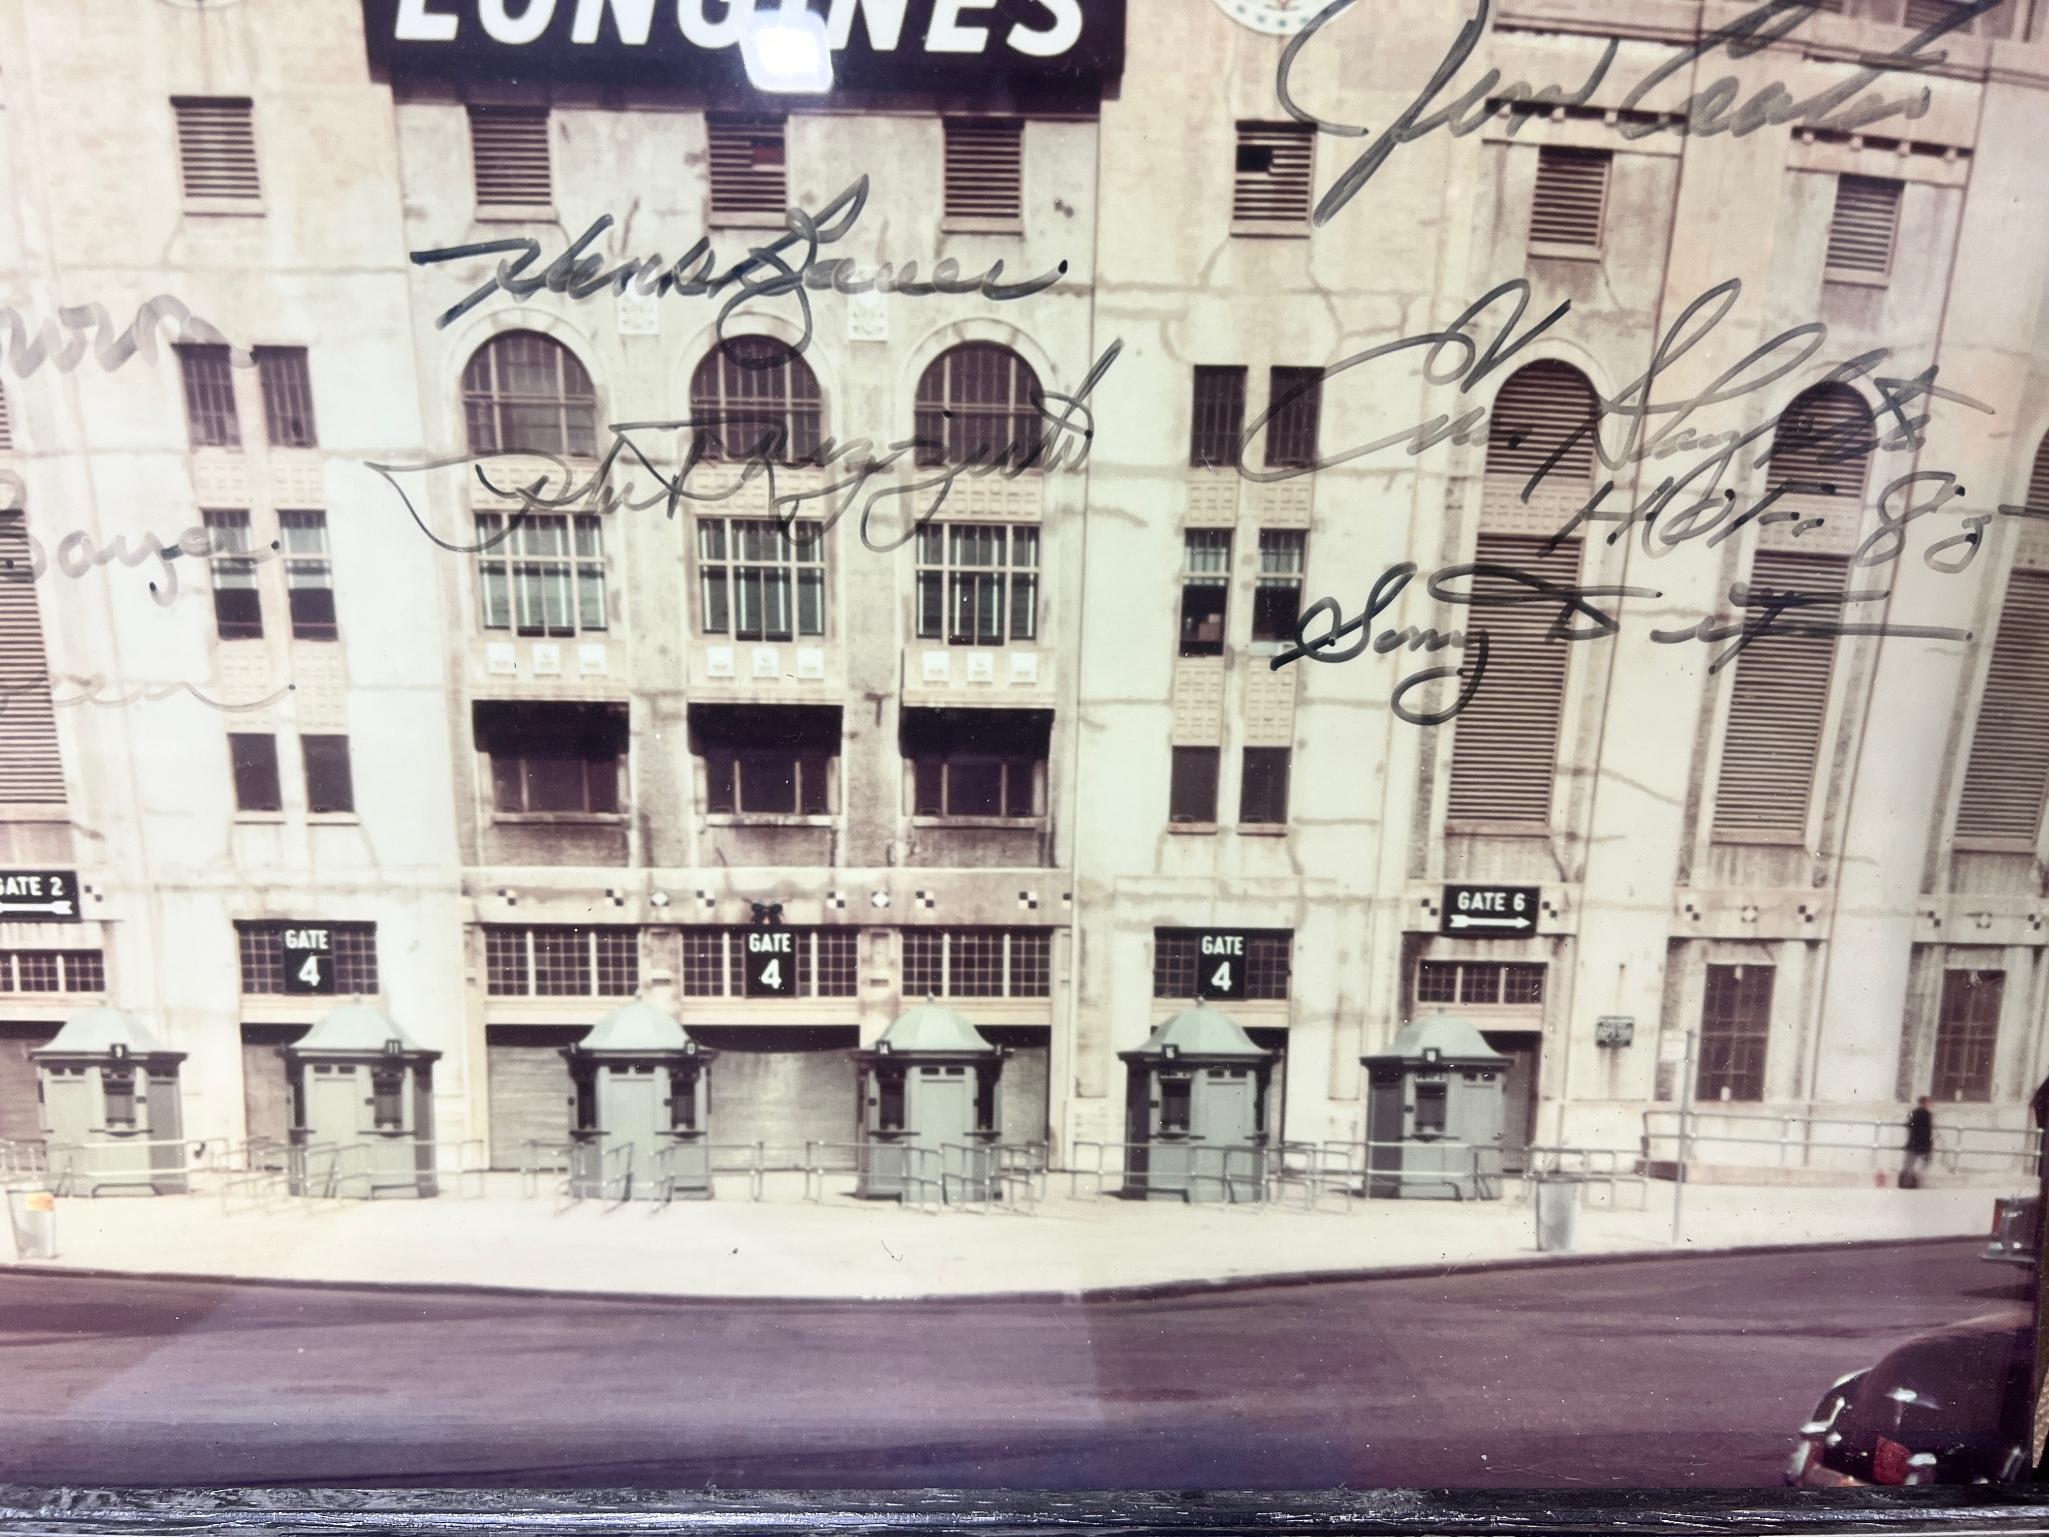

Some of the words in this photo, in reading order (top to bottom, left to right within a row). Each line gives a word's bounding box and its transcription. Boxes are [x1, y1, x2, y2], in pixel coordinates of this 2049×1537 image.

[394, 0, 1082, 57] LONGNES
[49, 876, 65, 896] 2
[1457, 891, 1507, 911] GATE
[1513, 892, 1526, 911] 6
[284, 929, 329, 950] GATE
[749, 932, 792, 953] GATE
[1201, 935, 1244, 956] GATE
[299, 955, 321, 987] 4
[760, 958, 782, 989] 4
[1211, 961, 1232, 991] 4
